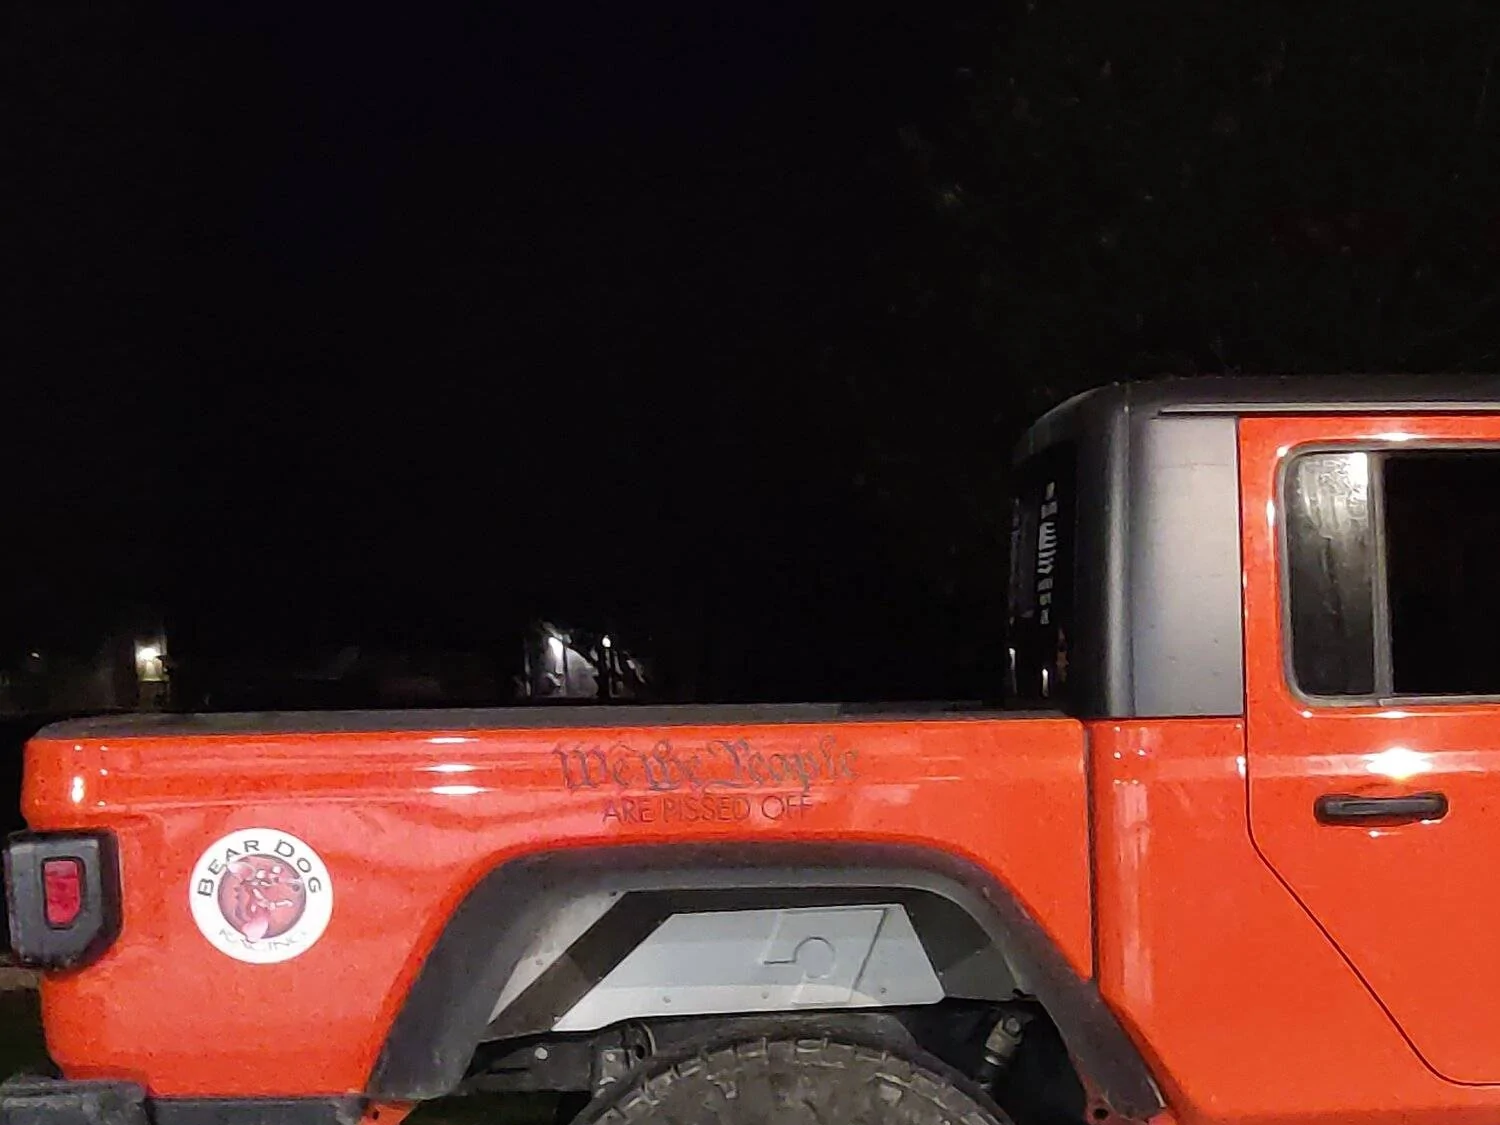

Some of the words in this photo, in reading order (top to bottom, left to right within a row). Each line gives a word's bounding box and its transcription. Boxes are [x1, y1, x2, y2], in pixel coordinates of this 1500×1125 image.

[699, 735, 859, 794] People
[602, 796, 654, 824] ARE
[662, 796, 751, 823] PISSED
[761, 795, 814, 821] OFF
[197, 839, 261, 897] BEAR
[274, 839, 322, 894] DOG
